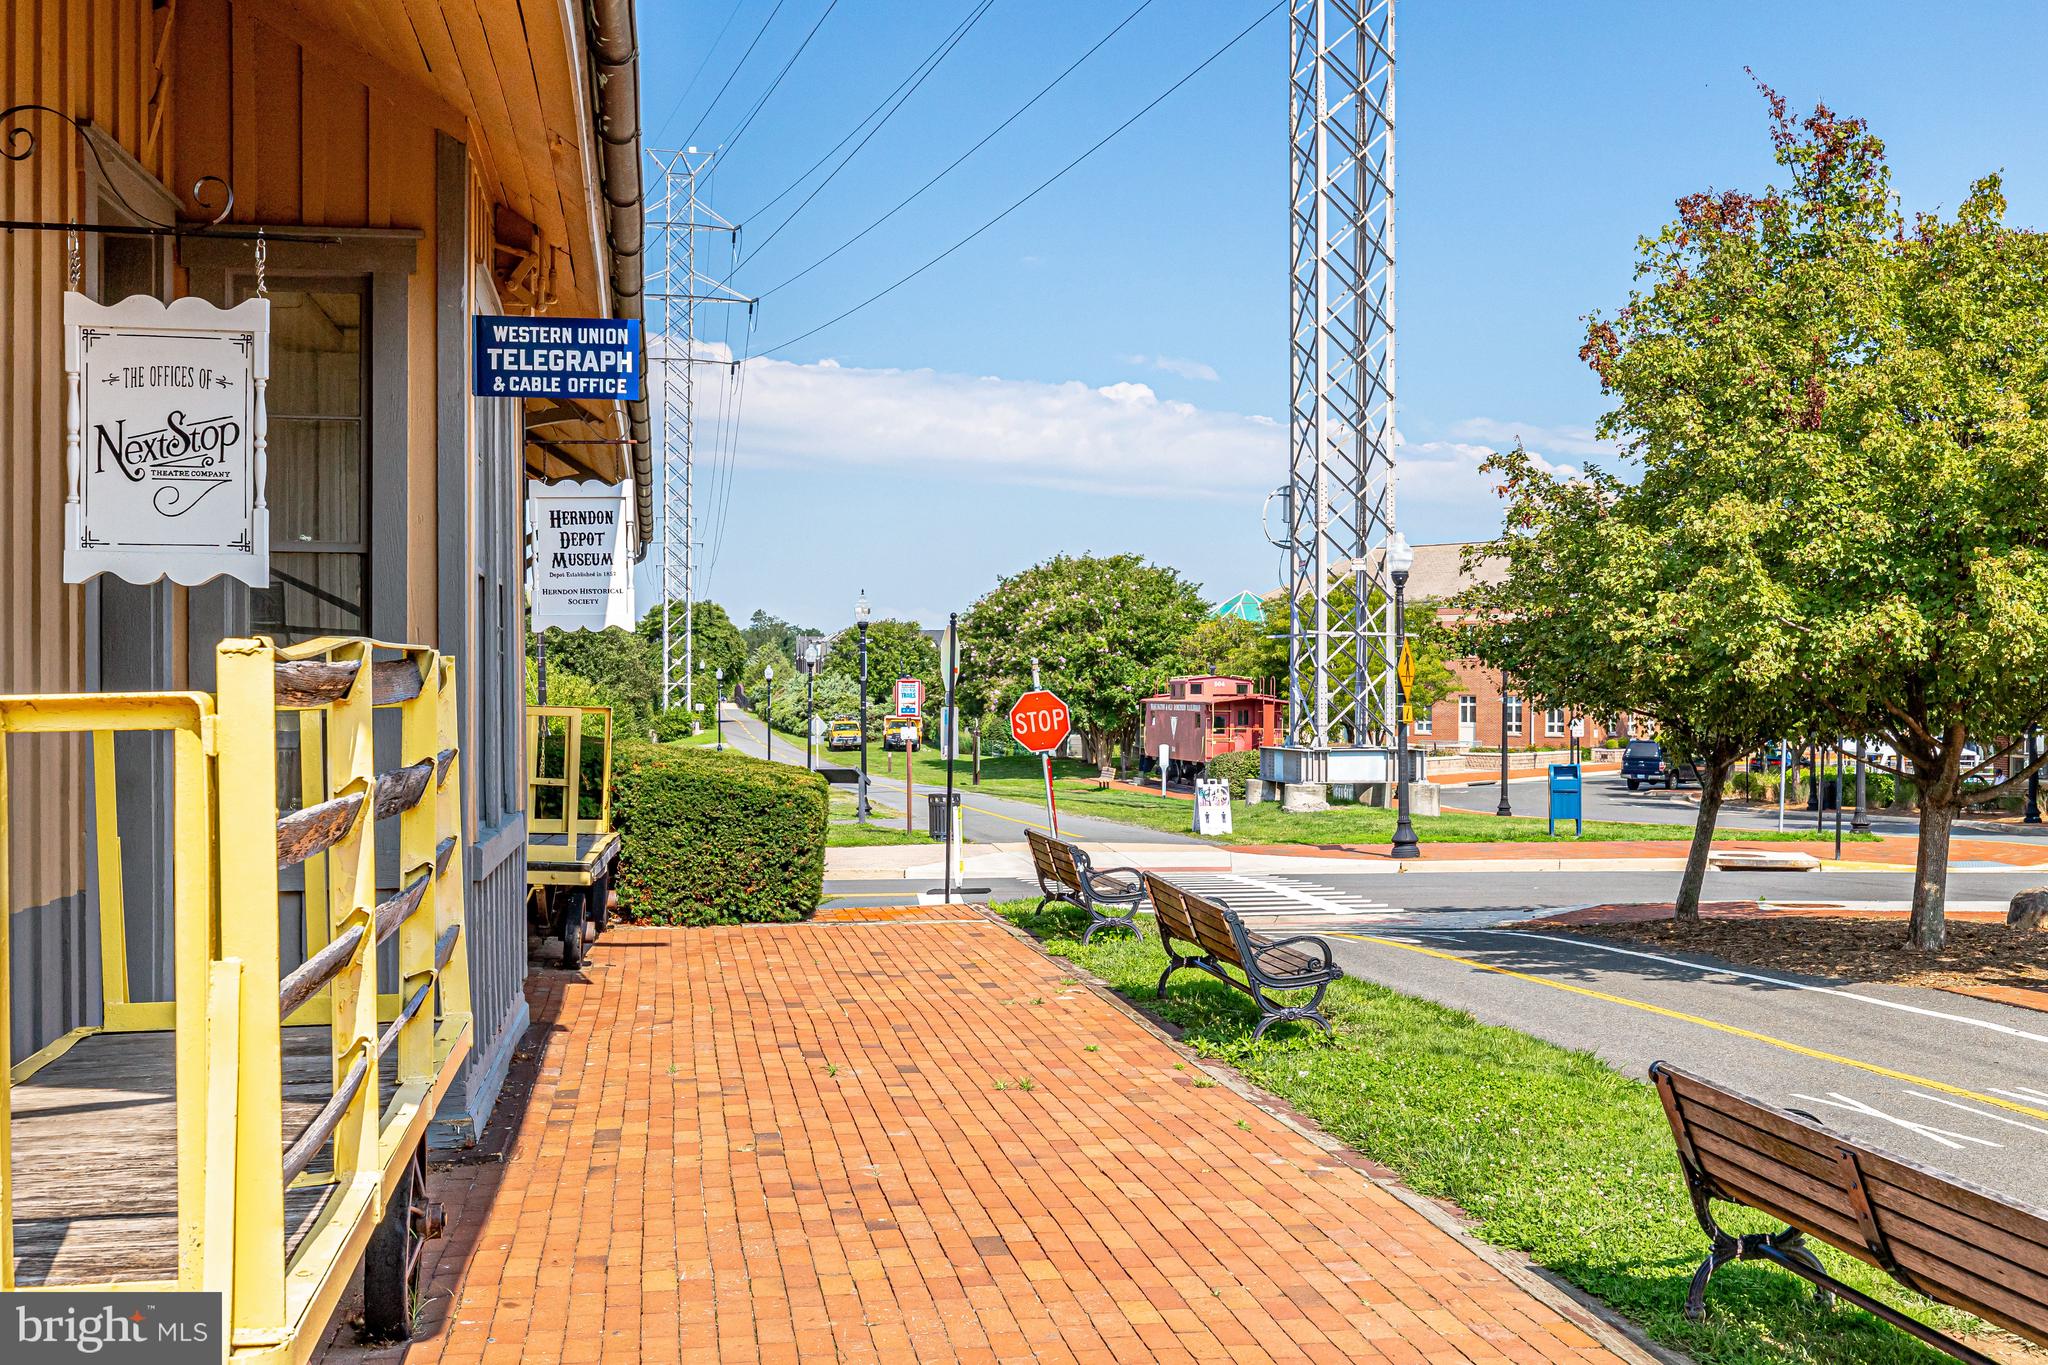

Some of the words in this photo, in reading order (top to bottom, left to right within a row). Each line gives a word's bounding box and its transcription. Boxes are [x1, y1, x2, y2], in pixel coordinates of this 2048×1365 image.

[493, 325, 572, 344] WESTERN
[577, 328, 629, 345] UNION
[487, 348, 633, 373] TELEGRAPH
[123, 365, 145, 388] THE
[150, 365, 194, 388] OFFICES
[199, 369, 213, 390] OF
[493, 376, 506, 392] &
[509, 376, 561, 392] CABLE
[568, 377, 627, 394] OFFICE
[150, 469, 190, 478] THEATRE
[191, 470, 231, 478] COMPANY
[549, 510, 614, 529] HERNDON
[560, 531, 606, 549] DEPOT
[552, 552, 614, 569] MUSEUM
[542, 588, 578, 596] HERNDON
[580, 587, 625, 595] HISTORICAL
[1015, 708, 1065, 735] STOP
